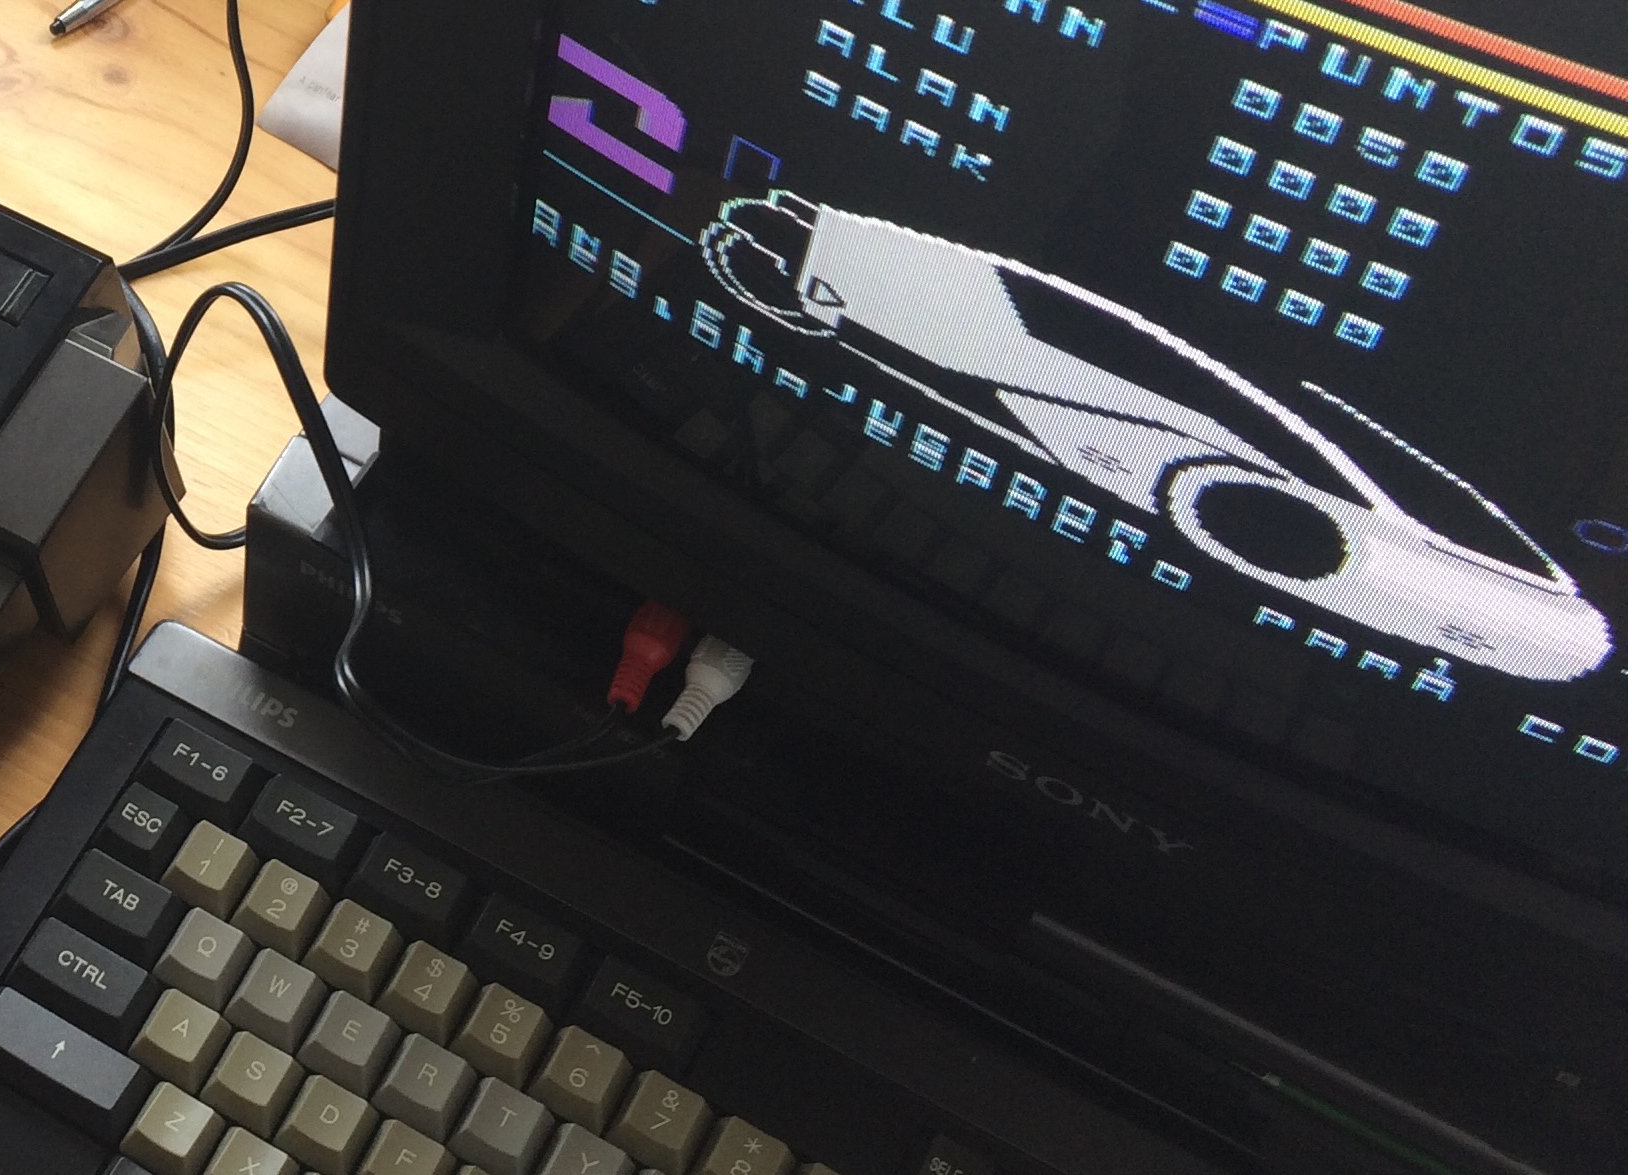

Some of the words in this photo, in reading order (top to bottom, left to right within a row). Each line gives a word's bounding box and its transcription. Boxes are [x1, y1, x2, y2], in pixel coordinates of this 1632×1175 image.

[1258, 18, 1628, 180] PUNTOS
[817, 19, 1011, 132] ALAN
[1207, 135, 1440, 249] 0000
[1231, 78, 1469, 193] 0050
[802, 69, 993, 182] SARK
[1185, 189, 1411, 301] 0000
[1163, 240, 1384, 350] 0000
[1517, 714, 1620, 765] CO
[173, 743, 229, 781] F1-6
[986, 750, 1195, 856] SONY
[121, 802, 163, 833] ESC
[277, 799, 334, 837] F2-7
[200, 860, 212, 876] 1
[383, 858, 443, 899] F3-8
[103, 879, 140, 911] TAB
[280, 878, 299, 895] @
[267, 899, 286, 919] 2
[355, 918, 371, 934] #
[197, 936, 217, 958] Q
[339, 938, 359, 959] 3
[495, 919, 555, 961] F4-9
[58, 950, 108, 990] CTRL
[427, 958, 445, 978] $
[269, 974, 292, 998] W
[414, 983, 432, 1000] 4
[499, 999, 525, 1023] %
[611, 982, 673, 1025] F5-10
[172, 1018, 189, 1037] A
[342, 1020, 363, 1041] E
[489, 1024, 510, 1045] 5
[246, 1060, 266, 1081] S
[418, 1063, 438, 1086] R
[569, 1068, 589, 1088] 6
[164, 1111, 186, 1132] Z
[319, 1105, 340, 1124] D
[501, 1106, 517, 1127] T
[650, 1113, 671, 1130] 7
[238, 1157, 261, 1175] X
[394, 1149, 417, 1166] F
[580, 1152, 600, 1174] Y
[730, 1159, 751, 1175] 8
